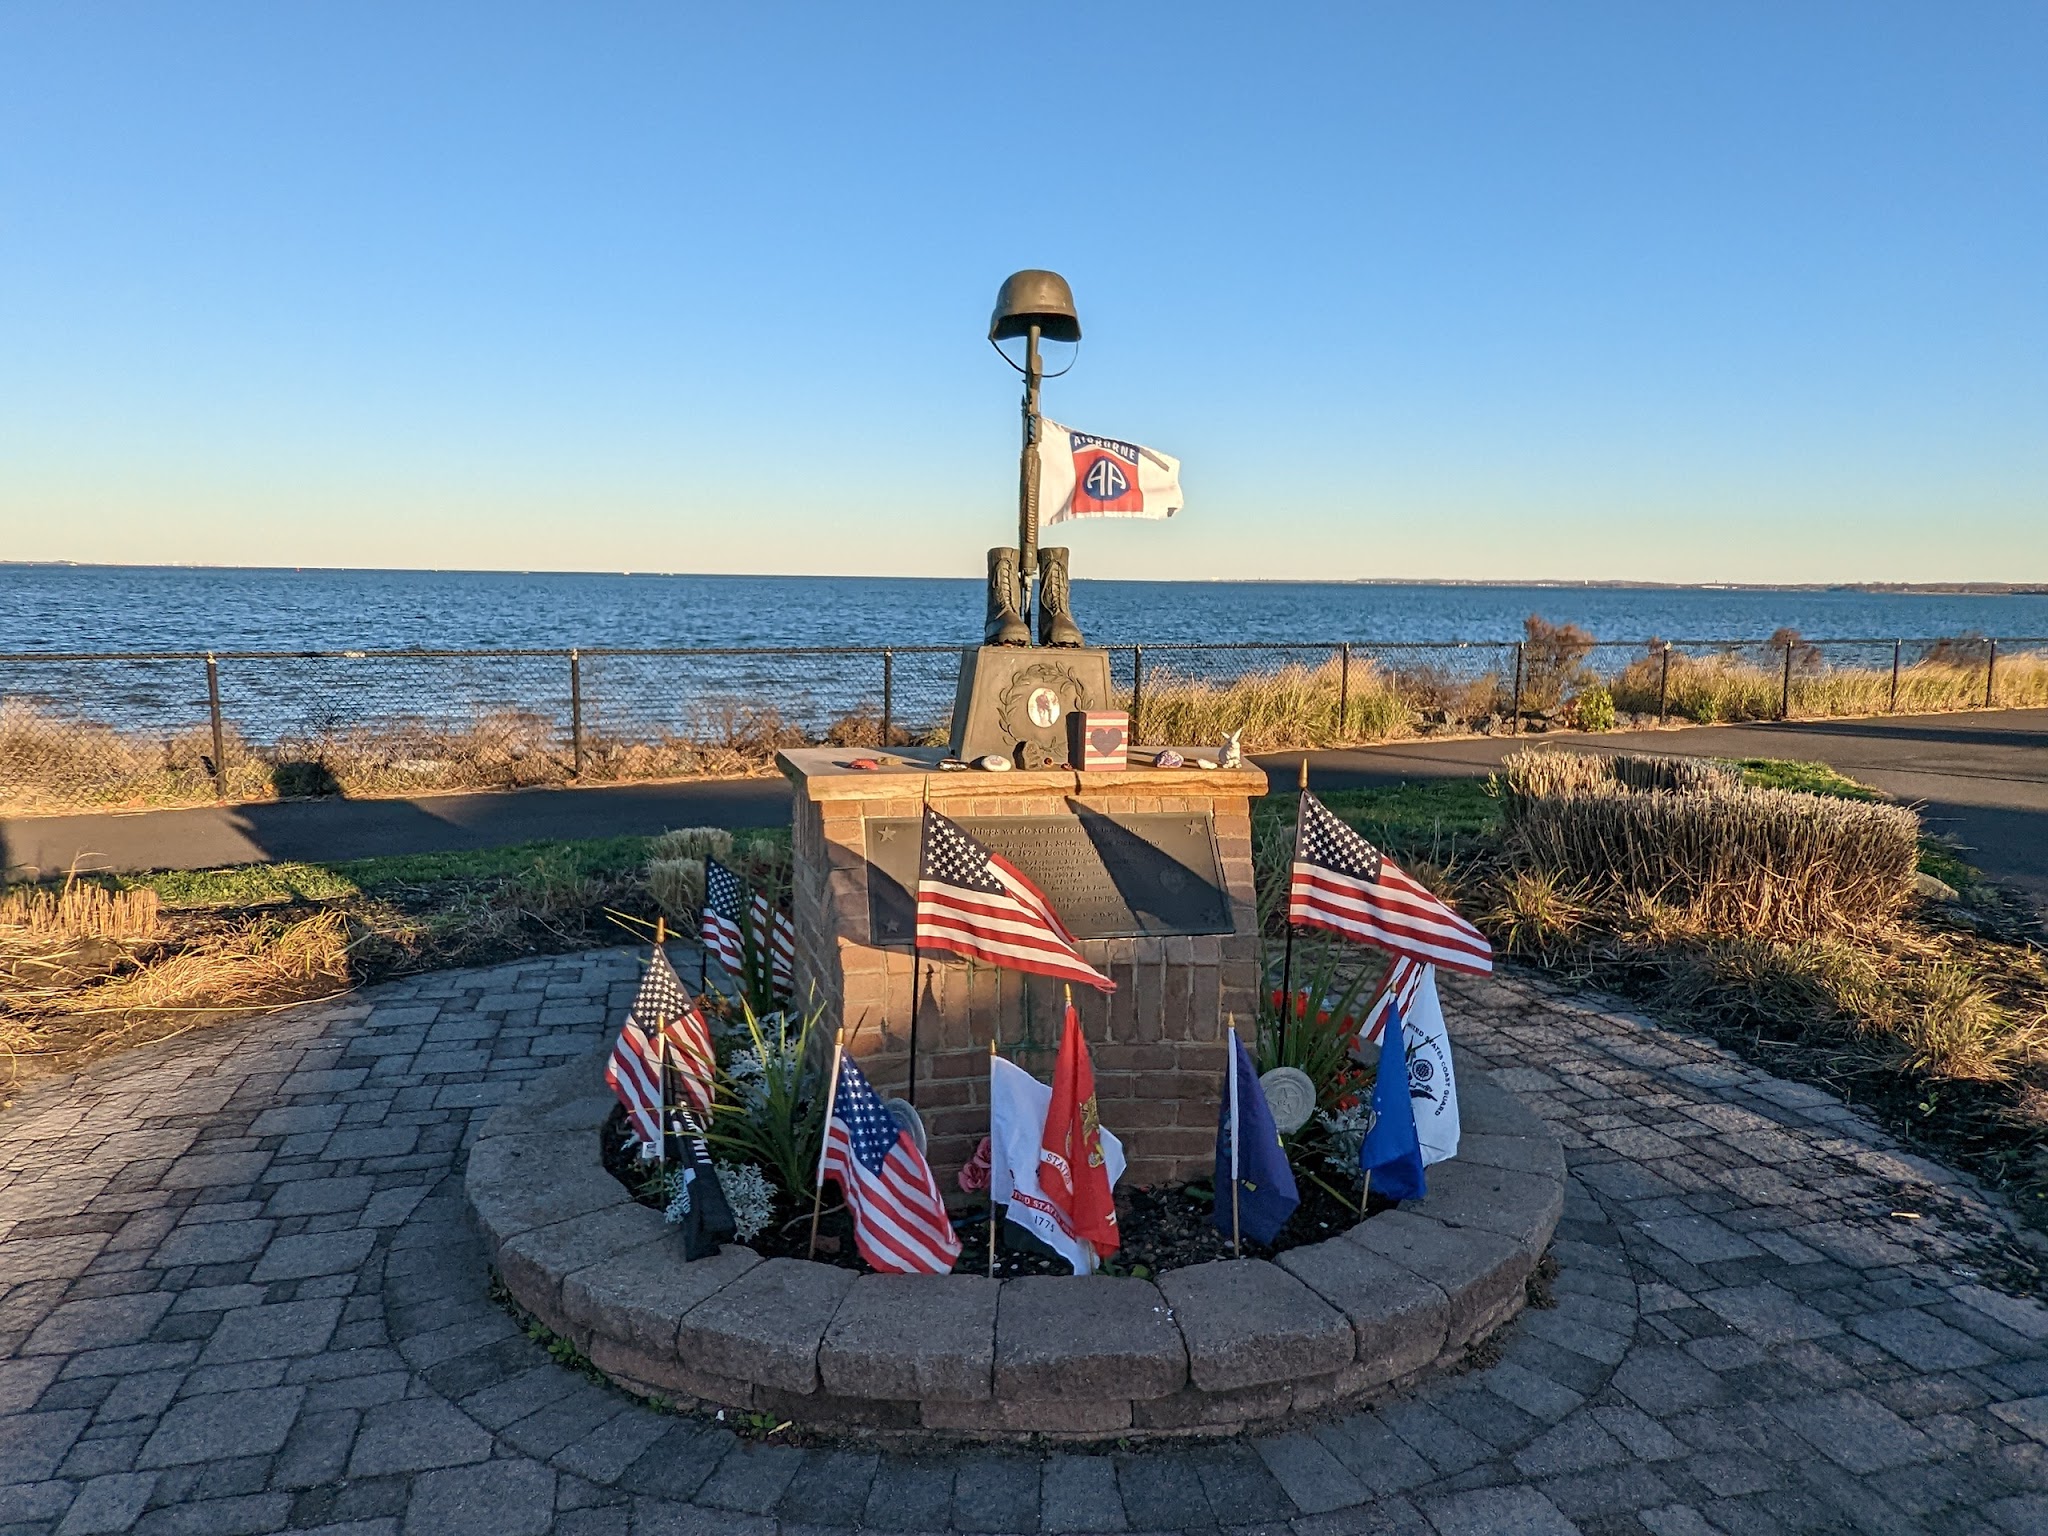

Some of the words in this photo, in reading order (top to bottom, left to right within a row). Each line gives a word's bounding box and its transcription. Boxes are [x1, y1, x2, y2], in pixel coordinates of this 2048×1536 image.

[1018, 823, 1031, 835] do
[1033, 826, 1045, 835] so
[1047, 823, 1067, 835] that
[1441, 1061, 1450, 1087] COAST
[1434, 1089, 1450, 1116] GUARD
[1034, 1215, 1055, 1233] 1775
